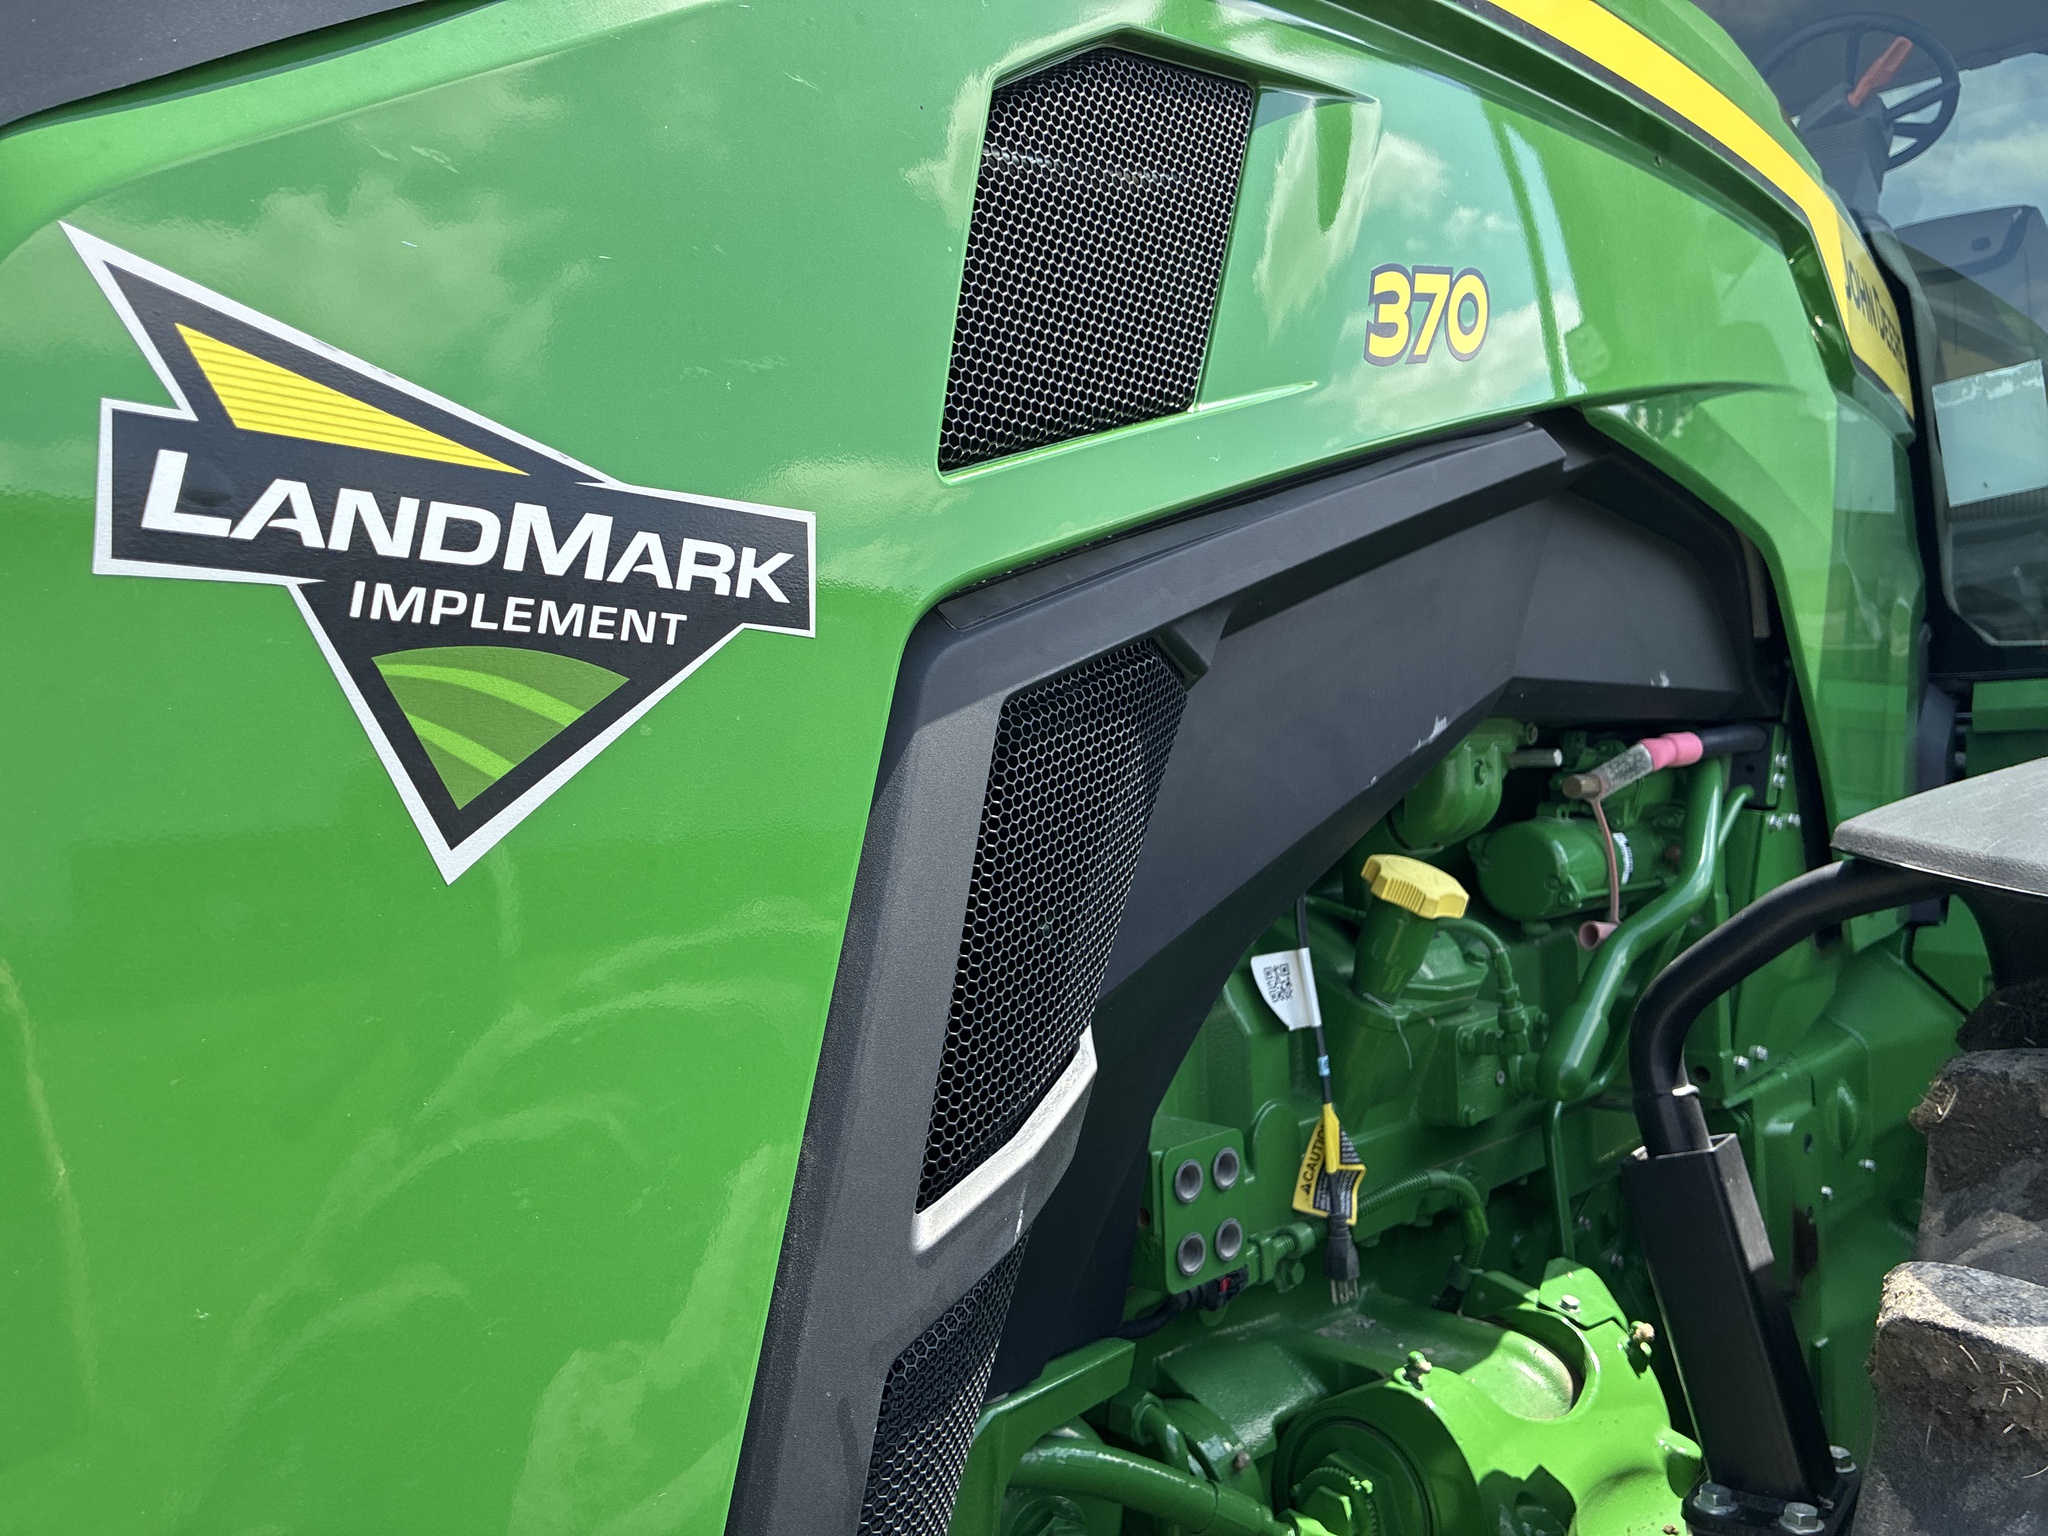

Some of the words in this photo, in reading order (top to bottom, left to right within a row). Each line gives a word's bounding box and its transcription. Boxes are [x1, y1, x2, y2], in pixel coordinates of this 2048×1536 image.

[1364, 263, 1490, 366] 370
[1842, 243, 1878, 332] JOHN
[350, 581, 687, 647] IMPLEMENT
[1302, 1125, 1325, 1182] CAUTIO
